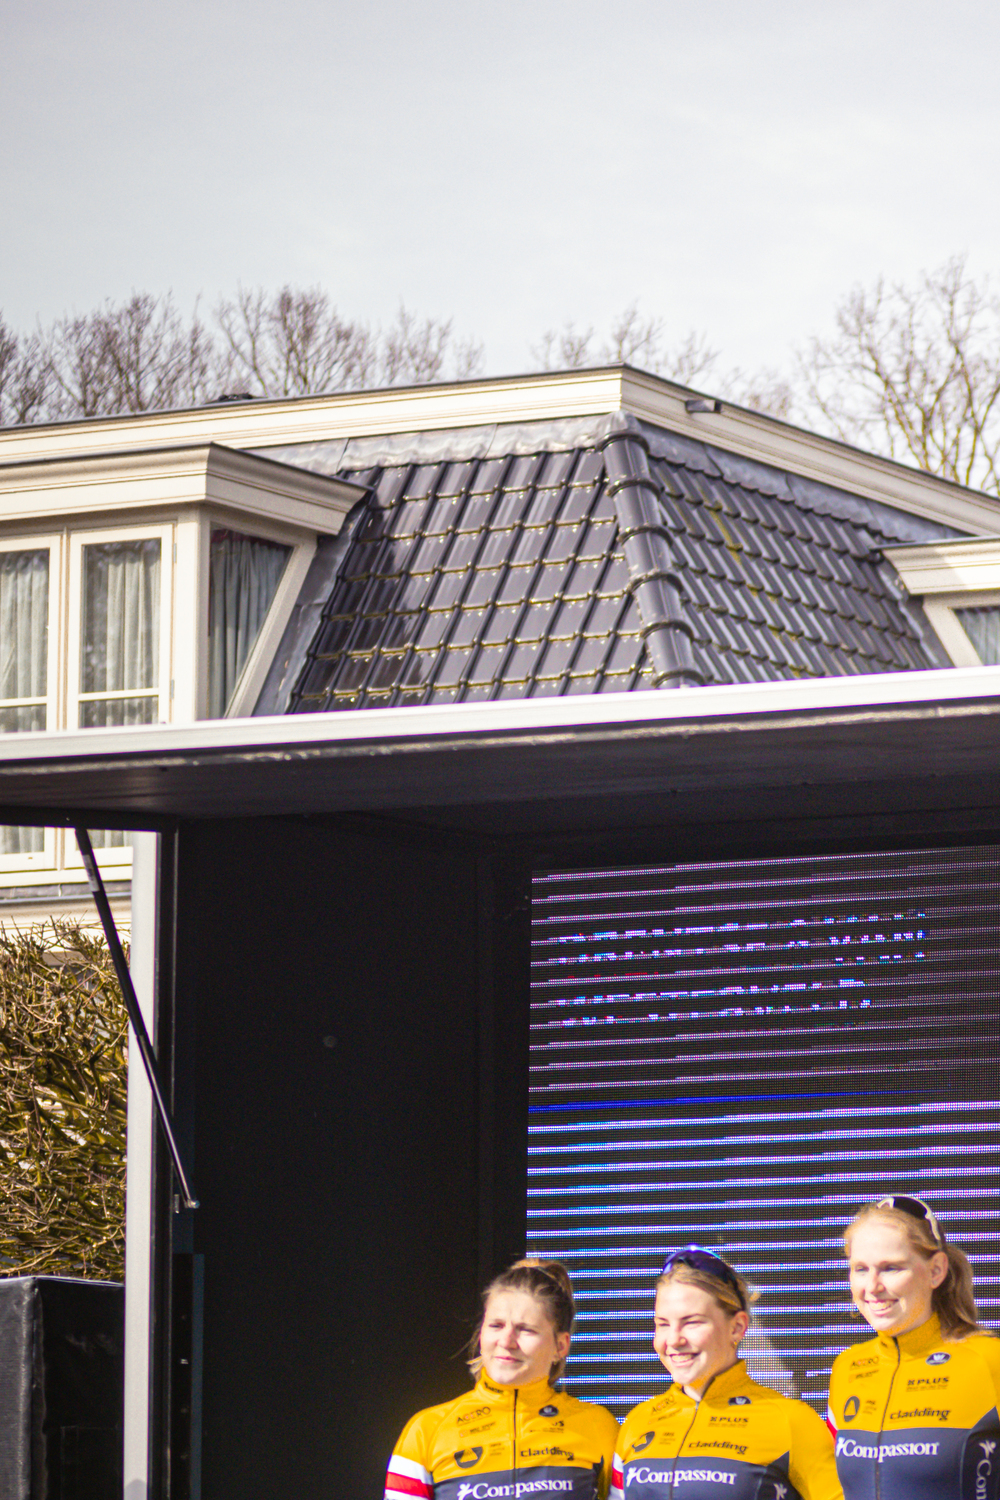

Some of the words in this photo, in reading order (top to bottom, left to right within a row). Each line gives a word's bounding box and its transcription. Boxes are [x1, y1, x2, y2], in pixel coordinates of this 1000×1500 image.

[456, 1406, 491, 1423] ACERO
[889, 1408, 951, 1421] cladding
[520, 1446, 575, 1461] cladding
[688, 1441, 748, 1455] cladding
[843, 1439, 938, 1463] Compassion
[637, 1467, 735, 1487] Compassion
[473, 1480, 573, 1500] Compassion
